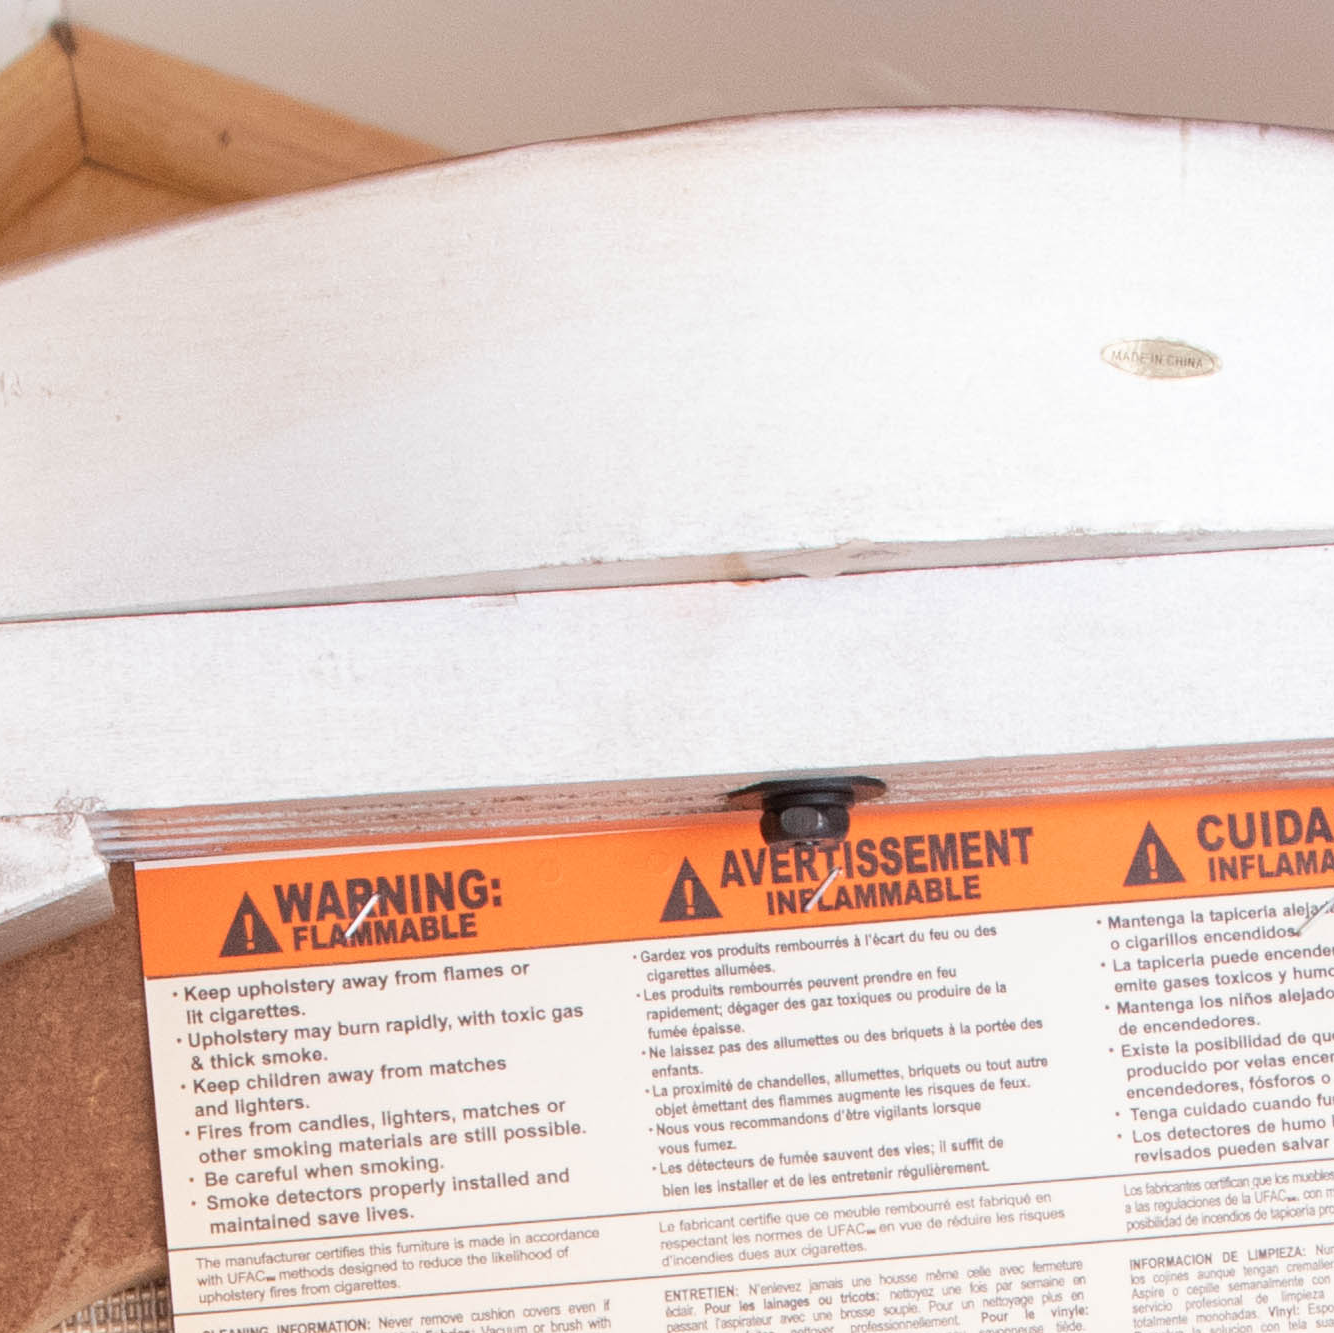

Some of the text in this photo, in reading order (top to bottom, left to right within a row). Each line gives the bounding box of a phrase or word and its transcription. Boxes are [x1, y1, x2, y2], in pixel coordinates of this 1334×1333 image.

[720, 827, 1032, 888] AVERTISSEMENT
[274, 869, 503, 924] WARNING:
[767, 875, 981, 915] INFLAMMABLE
[293, 912, 477, 950] FLAMMABLE
[183, 963, 530, 1003] Keep upholstery away from flames or
[646, 961, 775, 984] cigarettes allumées.
[1114, 978, 1157, 993] emite
[1162, 976, 1210, 992] gases
[1214, 970, 1273, 985] toxicos
[186, 1003, 305, 1025] lit cigarettes.
[187, 1006, 583, 1050] Upholstery may burn rapidly, with toxic gas
[1118, 1015, 1260, 1035] de encendedores.
[647, 1022, 745, 1039] fumée épaisse.
[190, 1047, 327, 1071] & thick smoke.
[651, 1064, 703, 1078] enfants.
[193, 1057, 507, 1095] Keep children away from matches
[194, 1096, 310, 1117] and lighters.
[197, 1100, 565, 1140] Fires from candles, lighters, matches or
[1130, 1107, 1177, 1122] Tenga
[1183, 1099, 1247, 1117] cuidado
[1252, 1094, 1311, 1112] cuando
[198, 1120, 586, 1164] other smoking materials are still possible.
[658, 1139, 737, 1155] vous fumez.
[1134, 1145, 1211, 1163] revisados
[1217, 1140, 1276, 1160] pueden
[1282, 1136, 1329, 1151] salvar
[204, 1155, 444, 1187] Be careful when smoking.
[206, 1167, 569, 1210] Smoke detectors properly installed and
[209, 1206, 414, 1234] maintained save lives.
